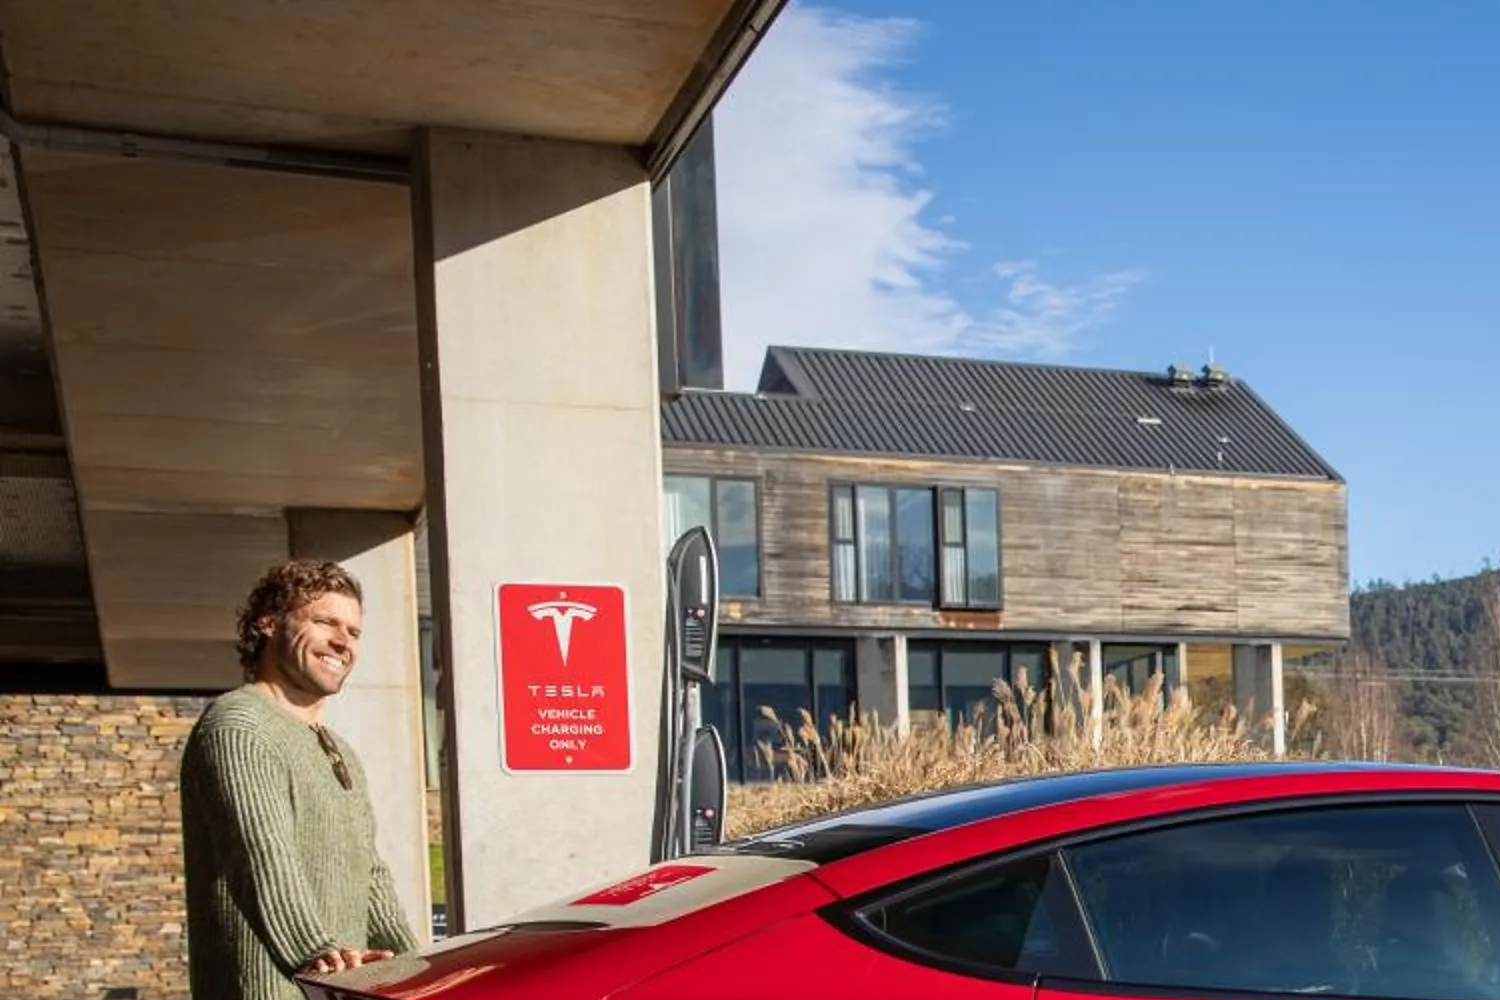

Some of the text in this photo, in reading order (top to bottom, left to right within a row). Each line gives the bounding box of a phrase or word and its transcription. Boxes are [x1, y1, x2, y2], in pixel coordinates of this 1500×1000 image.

[527, 684, 605, 697] TESLA
[538, 708, 597, 721] VEHICLE
[530, 723, 604, 736] CHARGING
[549, 739, 587, 751] ONLY
